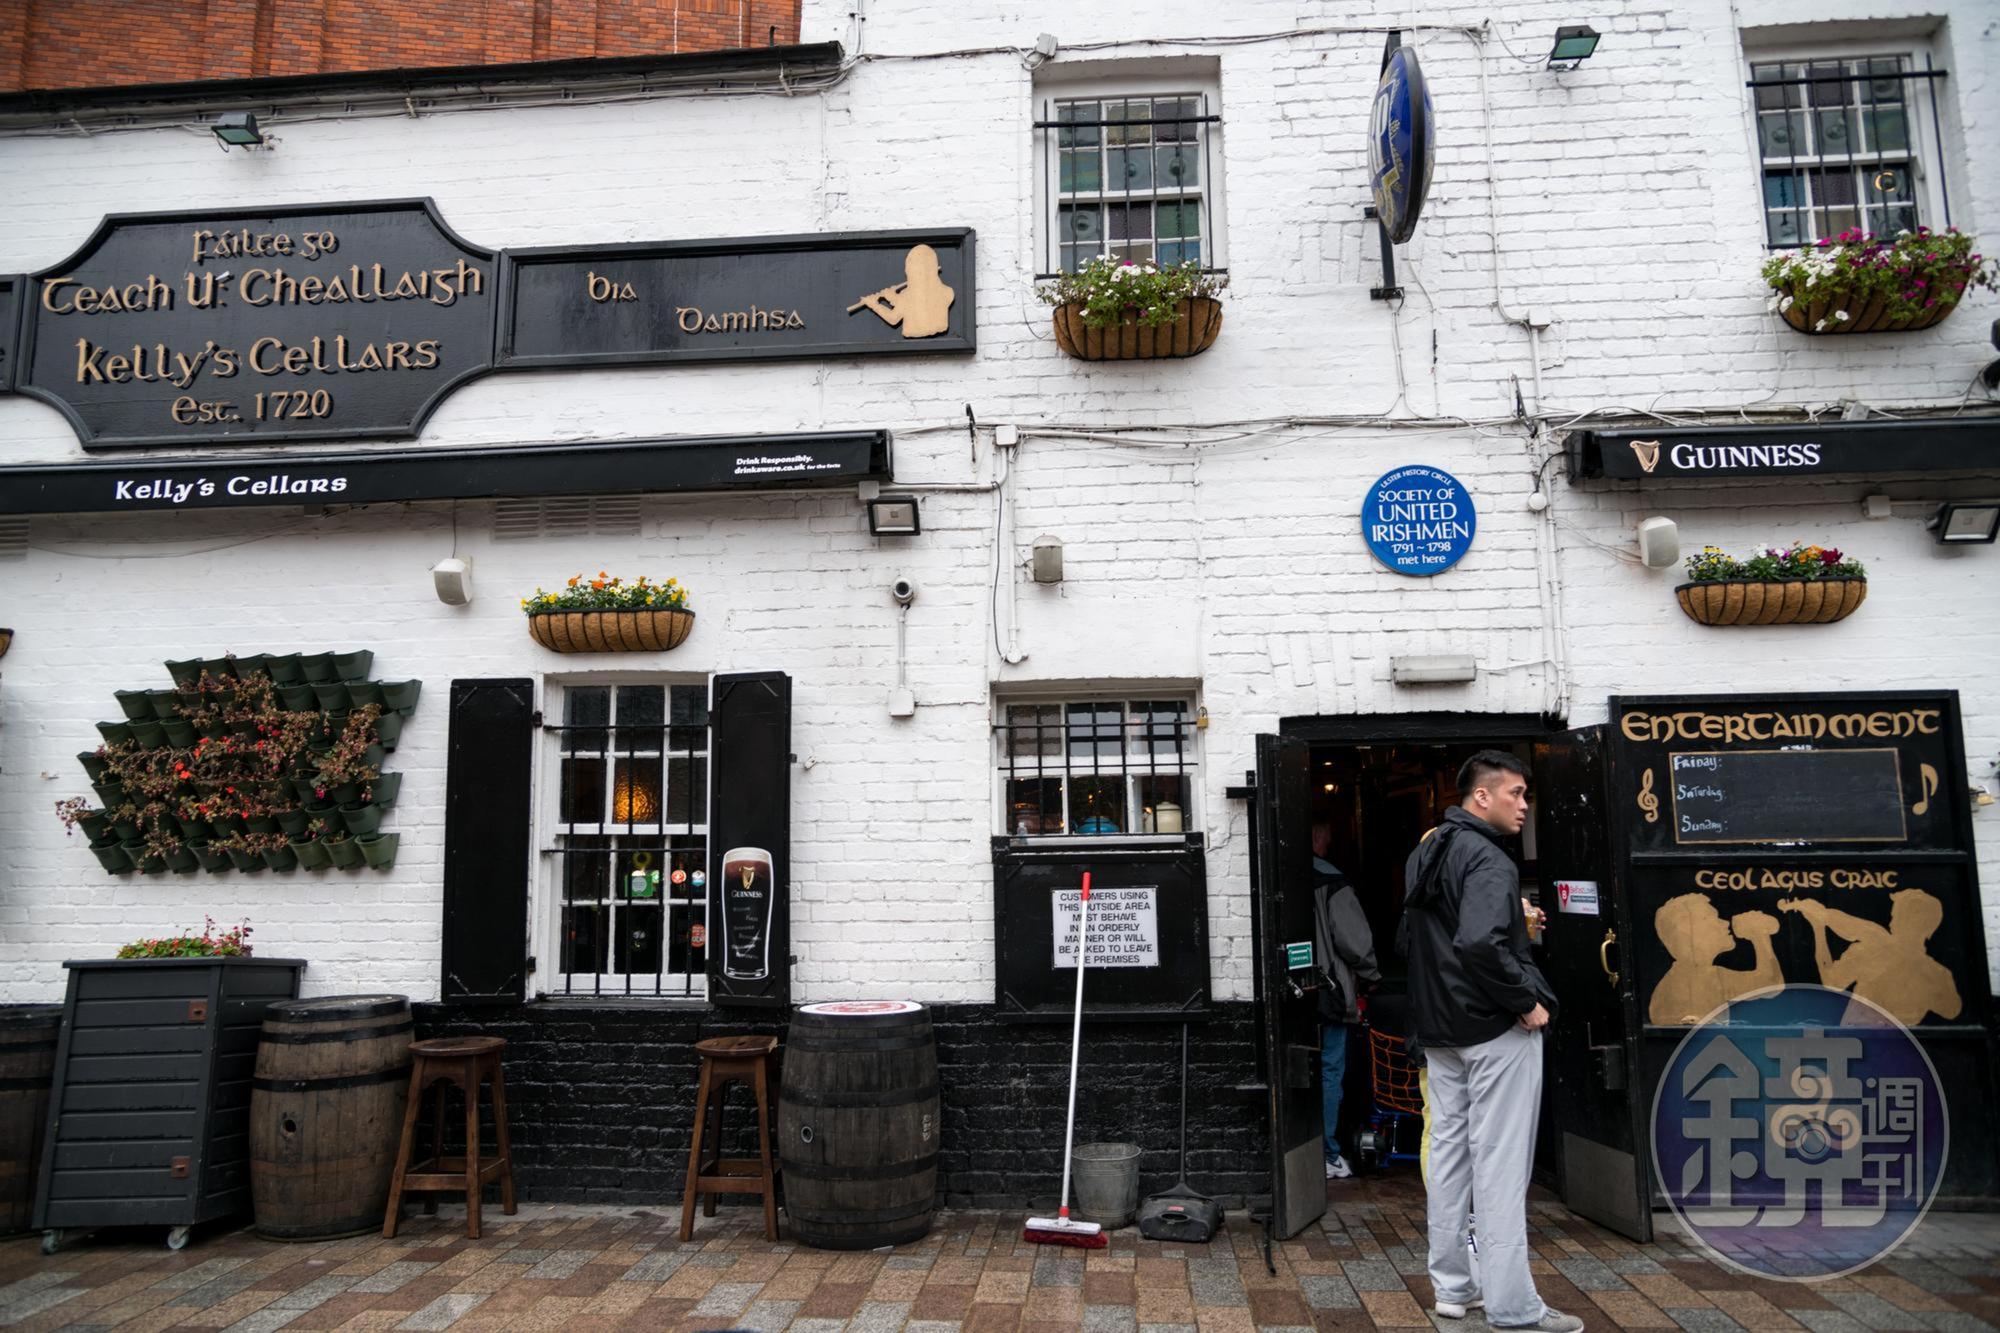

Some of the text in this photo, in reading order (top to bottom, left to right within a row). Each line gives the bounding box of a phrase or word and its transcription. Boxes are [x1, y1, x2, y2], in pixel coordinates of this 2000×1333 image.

[300, 230, 335, 257] go
[43, 274, 171, 313] Teach
[239, 259, 482, 304] Cheallaigh
[587, 271, 638, 301] Bia
[676, 304, 805, 332] Damhsa
[75, 334, 441, 387] Kelly's Cellars
[256, 389, 331, 419] 1720
[736, 455, 813, 466] Drink Responsibly.
[1670, 443, 1821, 469] GUINNESS
[734, 463, 805, 474] drinkaware.co.uk
[1380, 472, 1402, 488] ULSTER
[1402, 469, 1431, 478] HISTORY
[116, 475, 348, 503] Kelly's Cellars
[1378, 488, 1456, 503] SOCIETY OF
[1378, 502, 1458, 522] UNITED
[1372, 521, 1470, 542] IRISHMEN
[1391, 543, 1414, 554] 1791
[1426, 541, 1452, 552] 1798
[1398, 554, 1447, 565] met here
[1695, 868, 1898, 893] CEOL AGUS CRAIC
[731, 889, 763, 898] GUINNESS
[1120, 891, 1149, 900] USING
[1059, 903, 1079, 911] THIS
[1124, 902, 1151, 910] AREA
[1072, 912, 1137, 922] MST BEHAVE
[1069, 924, 1079, 932] IN
[1098, 923, 1140, 932] ORDERLY
[1064, 933, 1146, 943] MANER OR WILL
[1058, 944, 1153, 953] BE AKED TO LEAVE
[1072, 955, 1140, 964] TE PREMISES
